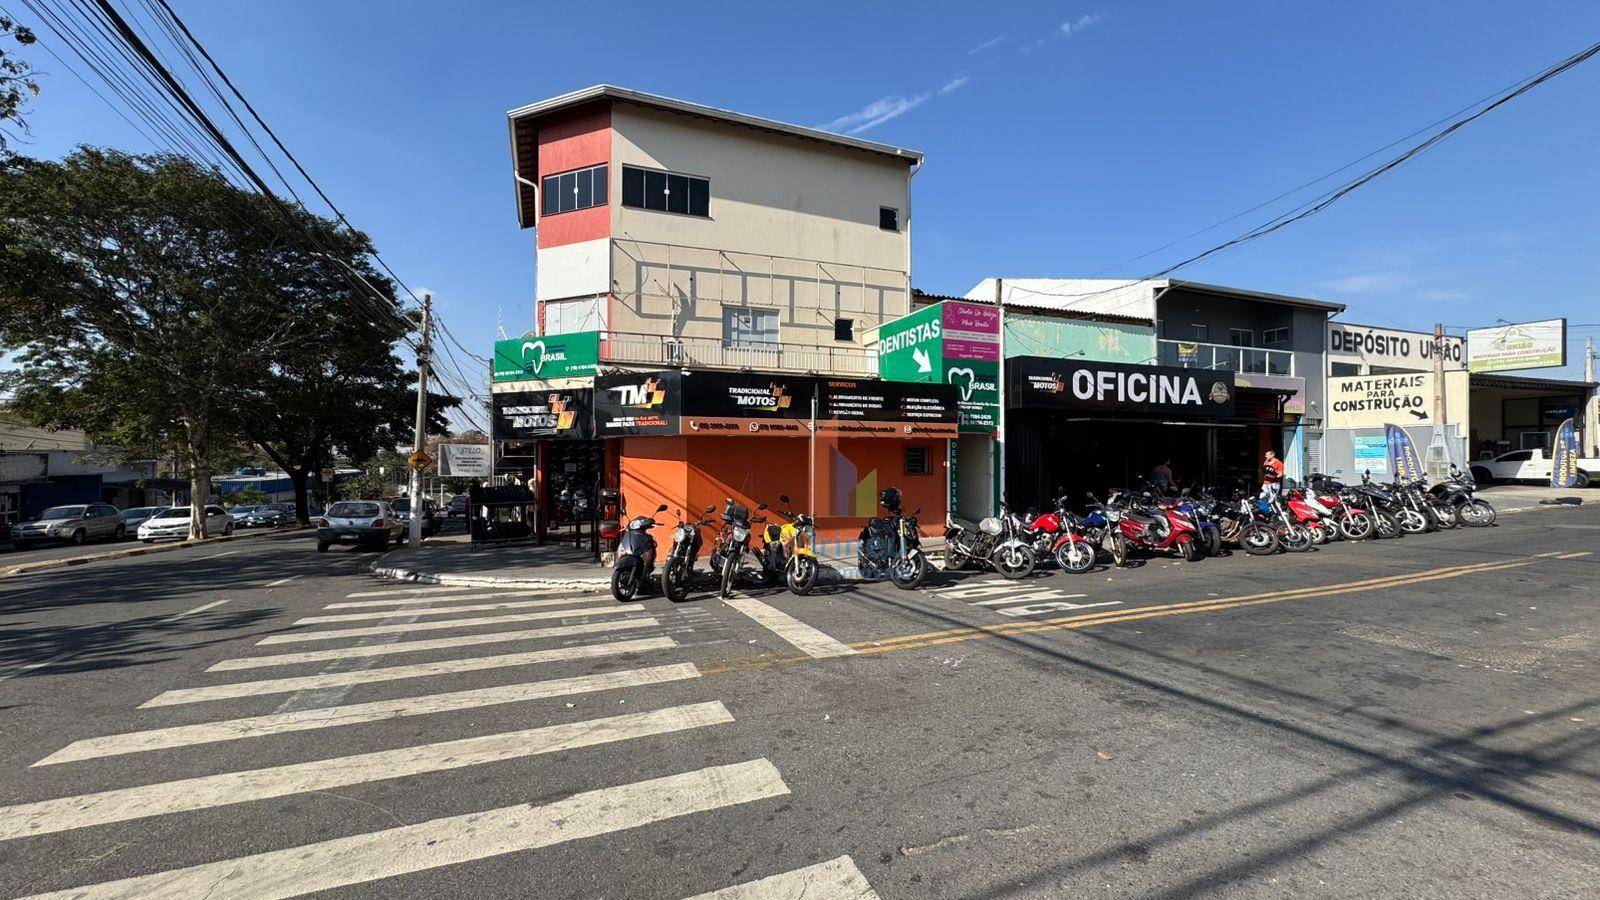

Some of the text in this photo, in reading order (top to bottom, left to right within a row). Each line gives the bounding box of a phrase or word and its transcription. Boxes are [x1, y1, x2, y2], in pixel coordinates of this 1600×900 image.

[880, 318, 941, 356] DENTISTAS
[1331, 329, 1461, 362] DEPÓSITO UNÃO
[541, 352, 567, 363] BRASIL
[728, 386, 771, 395] TRADICIONAL
[969, 381, 997, 391] BRASIL
[1033, 381, 1057, 390] MOTOS
[1072, 368, 1203, 405] OFICINA
[1341, 375, 1425, 393] MATERIAIS
[618, 384, 648, 406] TM
[737, 395, 776, 406] MOTOS
[1333, 394, 1424, 412] CONSTRUÇÃO
[1366, 390, 1395, 399] PARA
[512, 414, 558, 428] MOTOS
[1569, 448, 1577, 477] LIMPEZA
[951, 441, 959, 512] DENTISTAS
